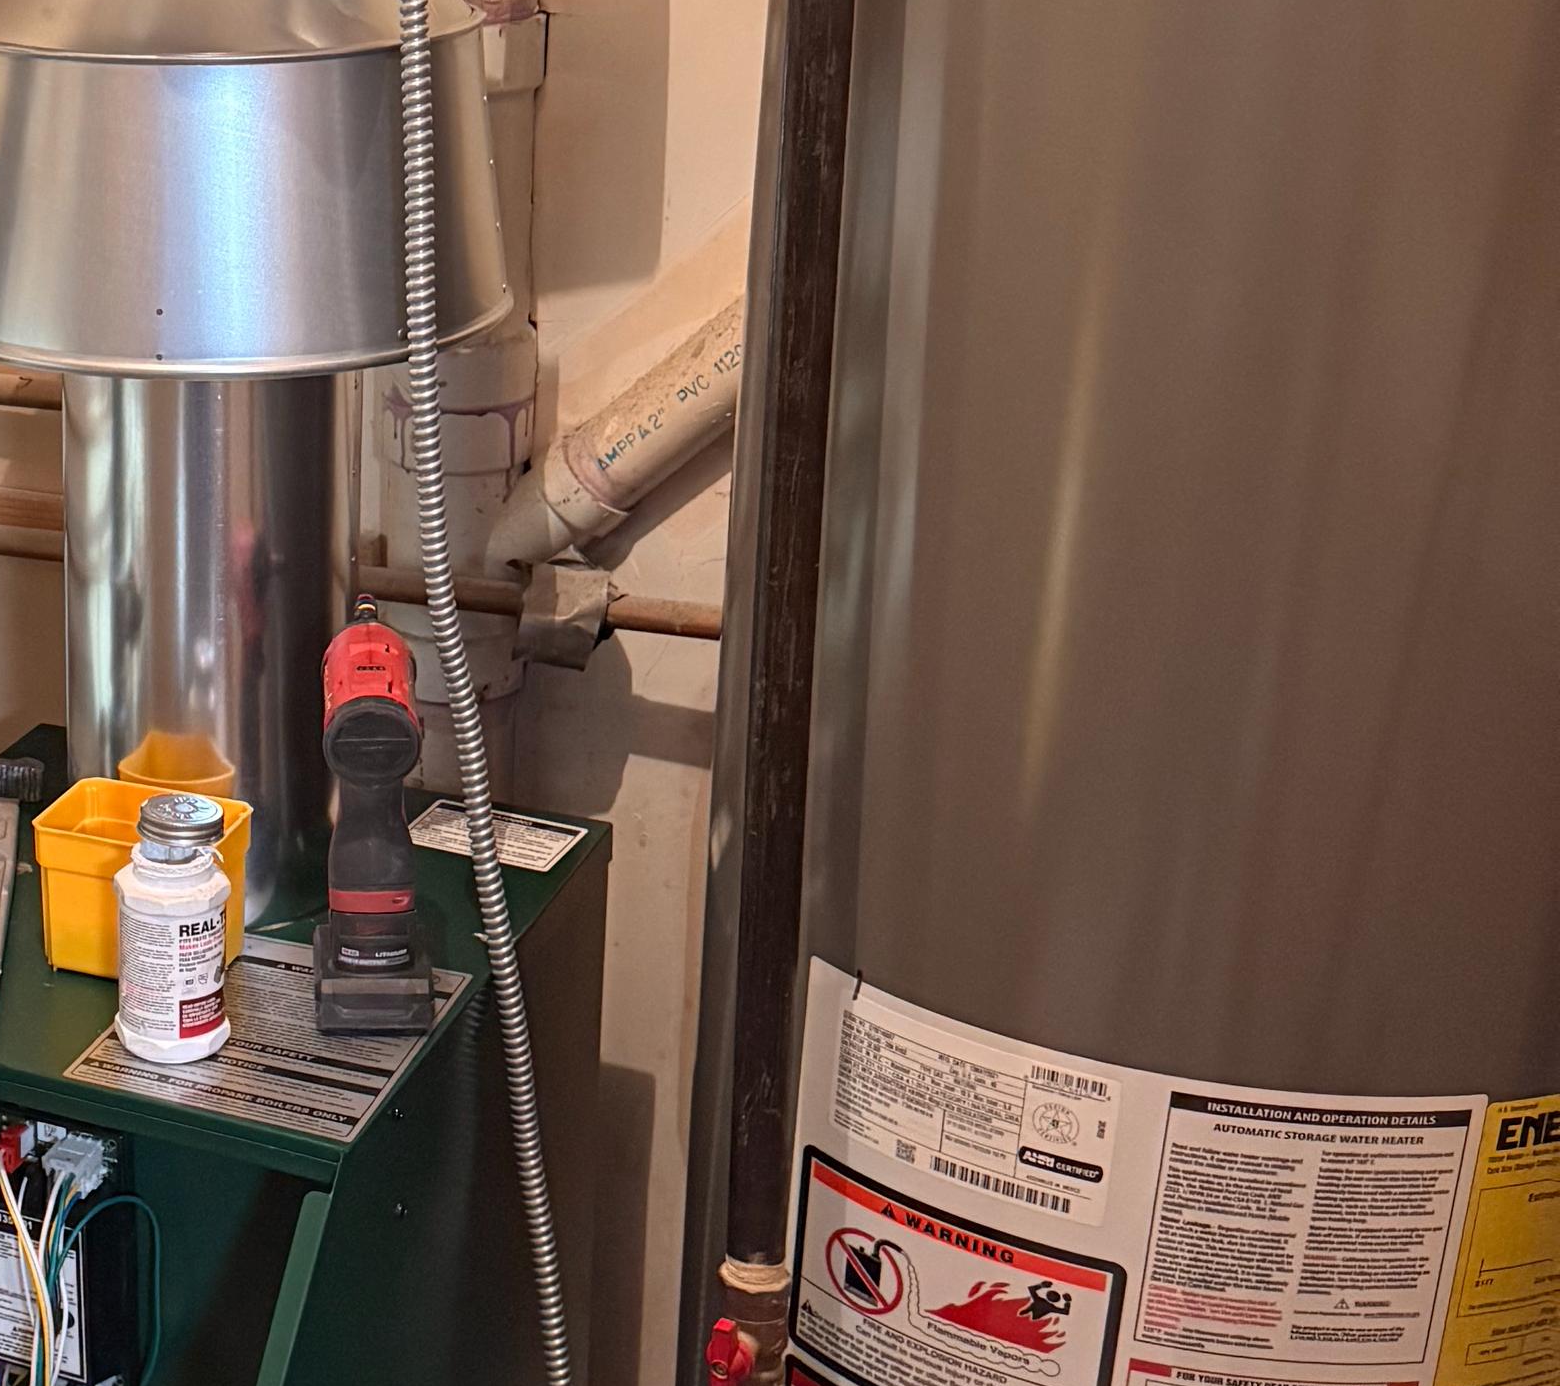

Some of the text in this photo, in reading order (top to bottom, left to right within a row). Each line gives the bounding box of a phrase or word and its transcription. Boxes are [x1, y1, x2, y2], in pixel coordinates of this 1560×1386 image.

[676, 373, 710, 403] PVC
[217, 1055, 265, 1072] NOTICE
[265, 1045, 313, 1062] SAFETY
[99, 1061, 158, 1081] WARNING
[168, 1076, 194, 1089] FOR
[196, 1082, 254, 1102] PROPANE
[255, 1096, 310, 1115] BOILERS
[312, 1107, 347, 1123] ONLY
[1208, 1101, 1437, 1125] INSTALLATION AND OPERATION DETAILS
[1213, 1123, 1424, 1145] AUTOMATIC STORAGE WATER HEATER
[905, 1213, 1014, 1265] WARNING
[863, 1318, 1007, 1384] FIRE AND EXPLOSION HAZARD
[927, 1321, 1030, 1365] Flammable Vapors
[1176, 1371, 1195, 1381] FOR
[1198, 1374, 1223, 1384] YOUR
